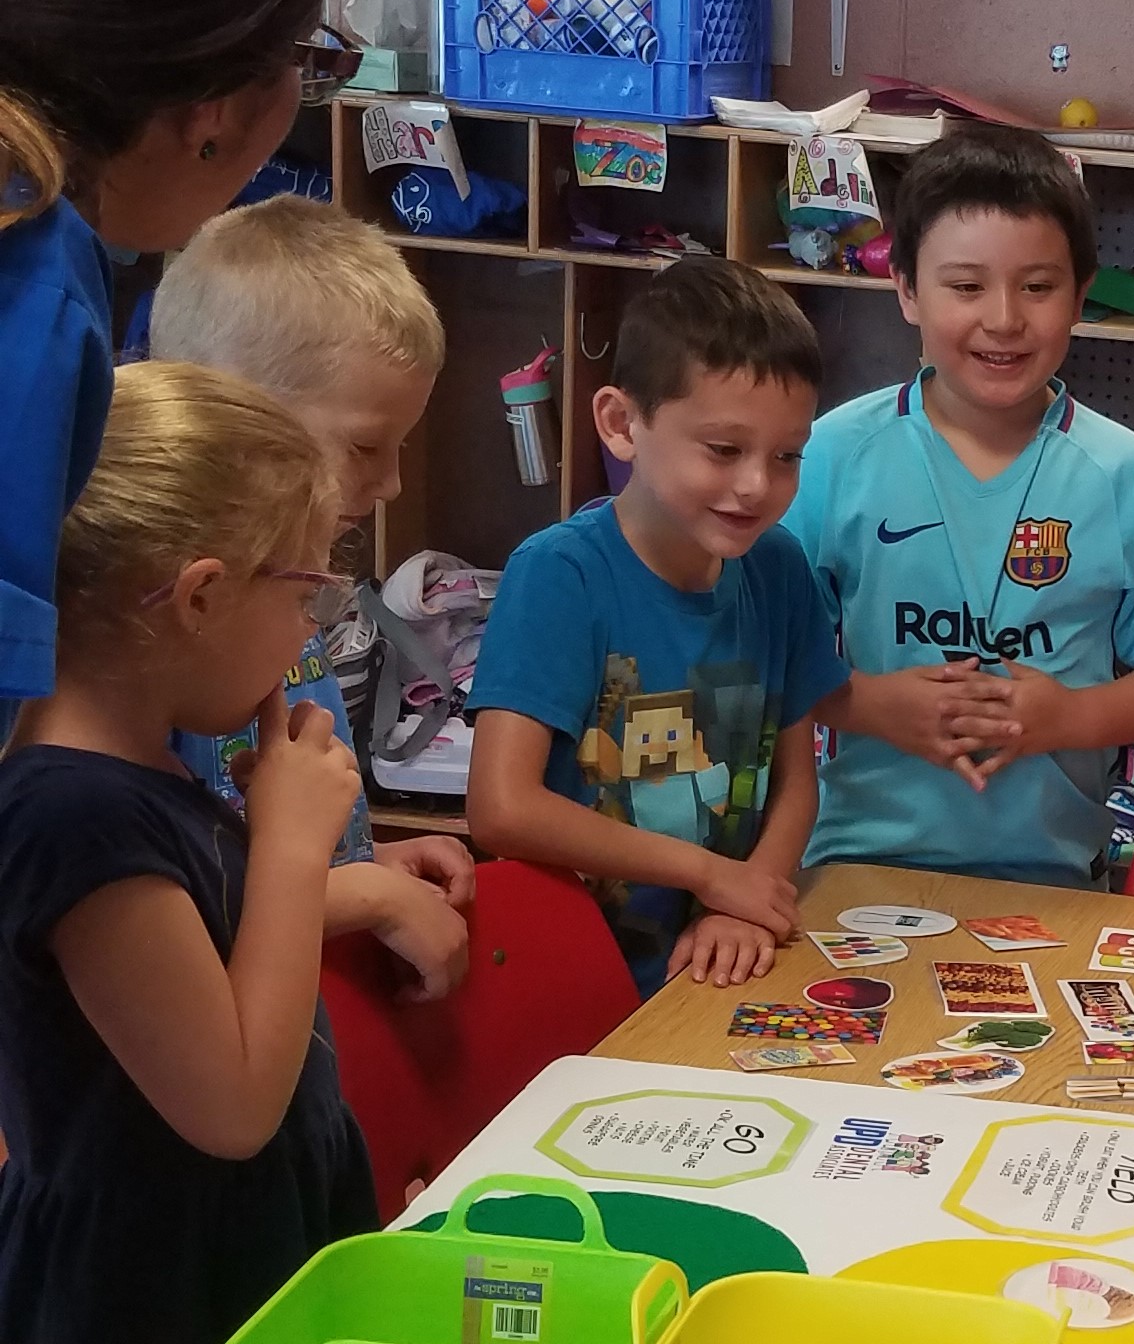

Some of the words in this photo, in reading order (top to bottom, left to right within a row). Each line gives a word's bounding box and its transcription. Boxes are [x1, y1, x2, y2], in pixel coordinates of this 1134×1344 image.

[706, 1123, 724, 1135] ALL
[723, 1124, 764, 1154] GO
[833, 1117, 893, 1147] UPD
[696, 1137, 715, 1150] THE
[681, 1151, 705, 1169] TIME
[812, 1144, 848, 1179] ASSOCIATES
[832, 1146, 877, 1180] DENTAL
[481, 1282, 527, 1301] spring
